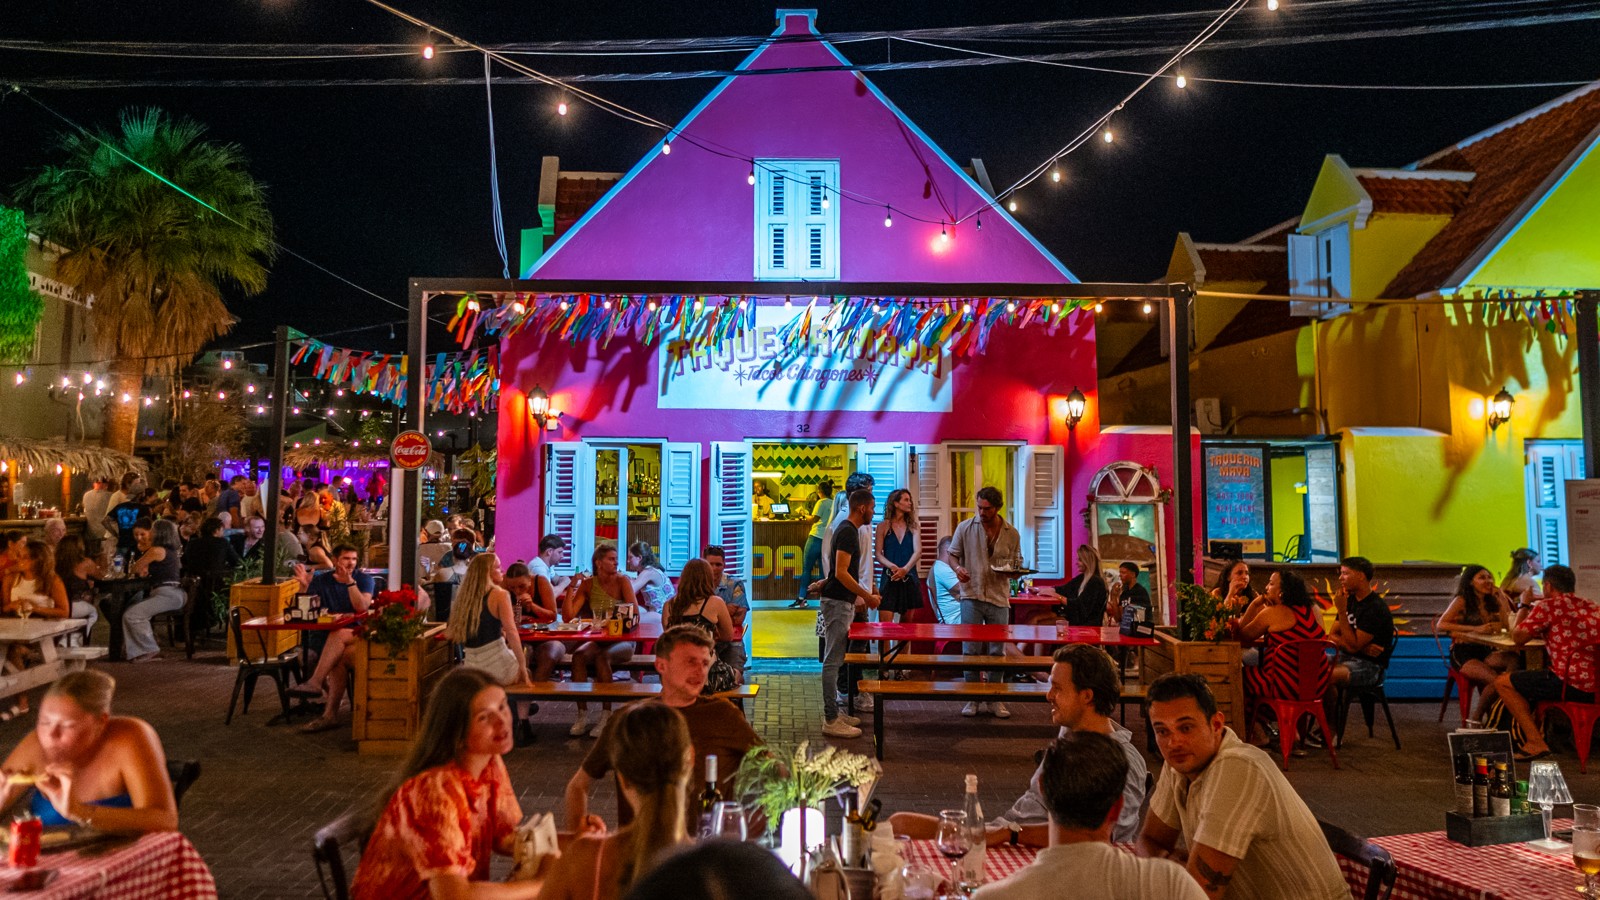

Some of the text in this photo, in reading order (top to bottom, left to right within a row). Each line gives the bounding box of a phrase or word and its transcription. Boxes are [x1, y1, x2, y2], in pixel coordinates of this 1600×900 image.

[748, 364, 865, 390] Tacos Chingones
[796, 424, 810, 433] 32
[1210, 454, 1260, 468] TAQUERIA
[1219, 466, 1250, 477] MAYA
